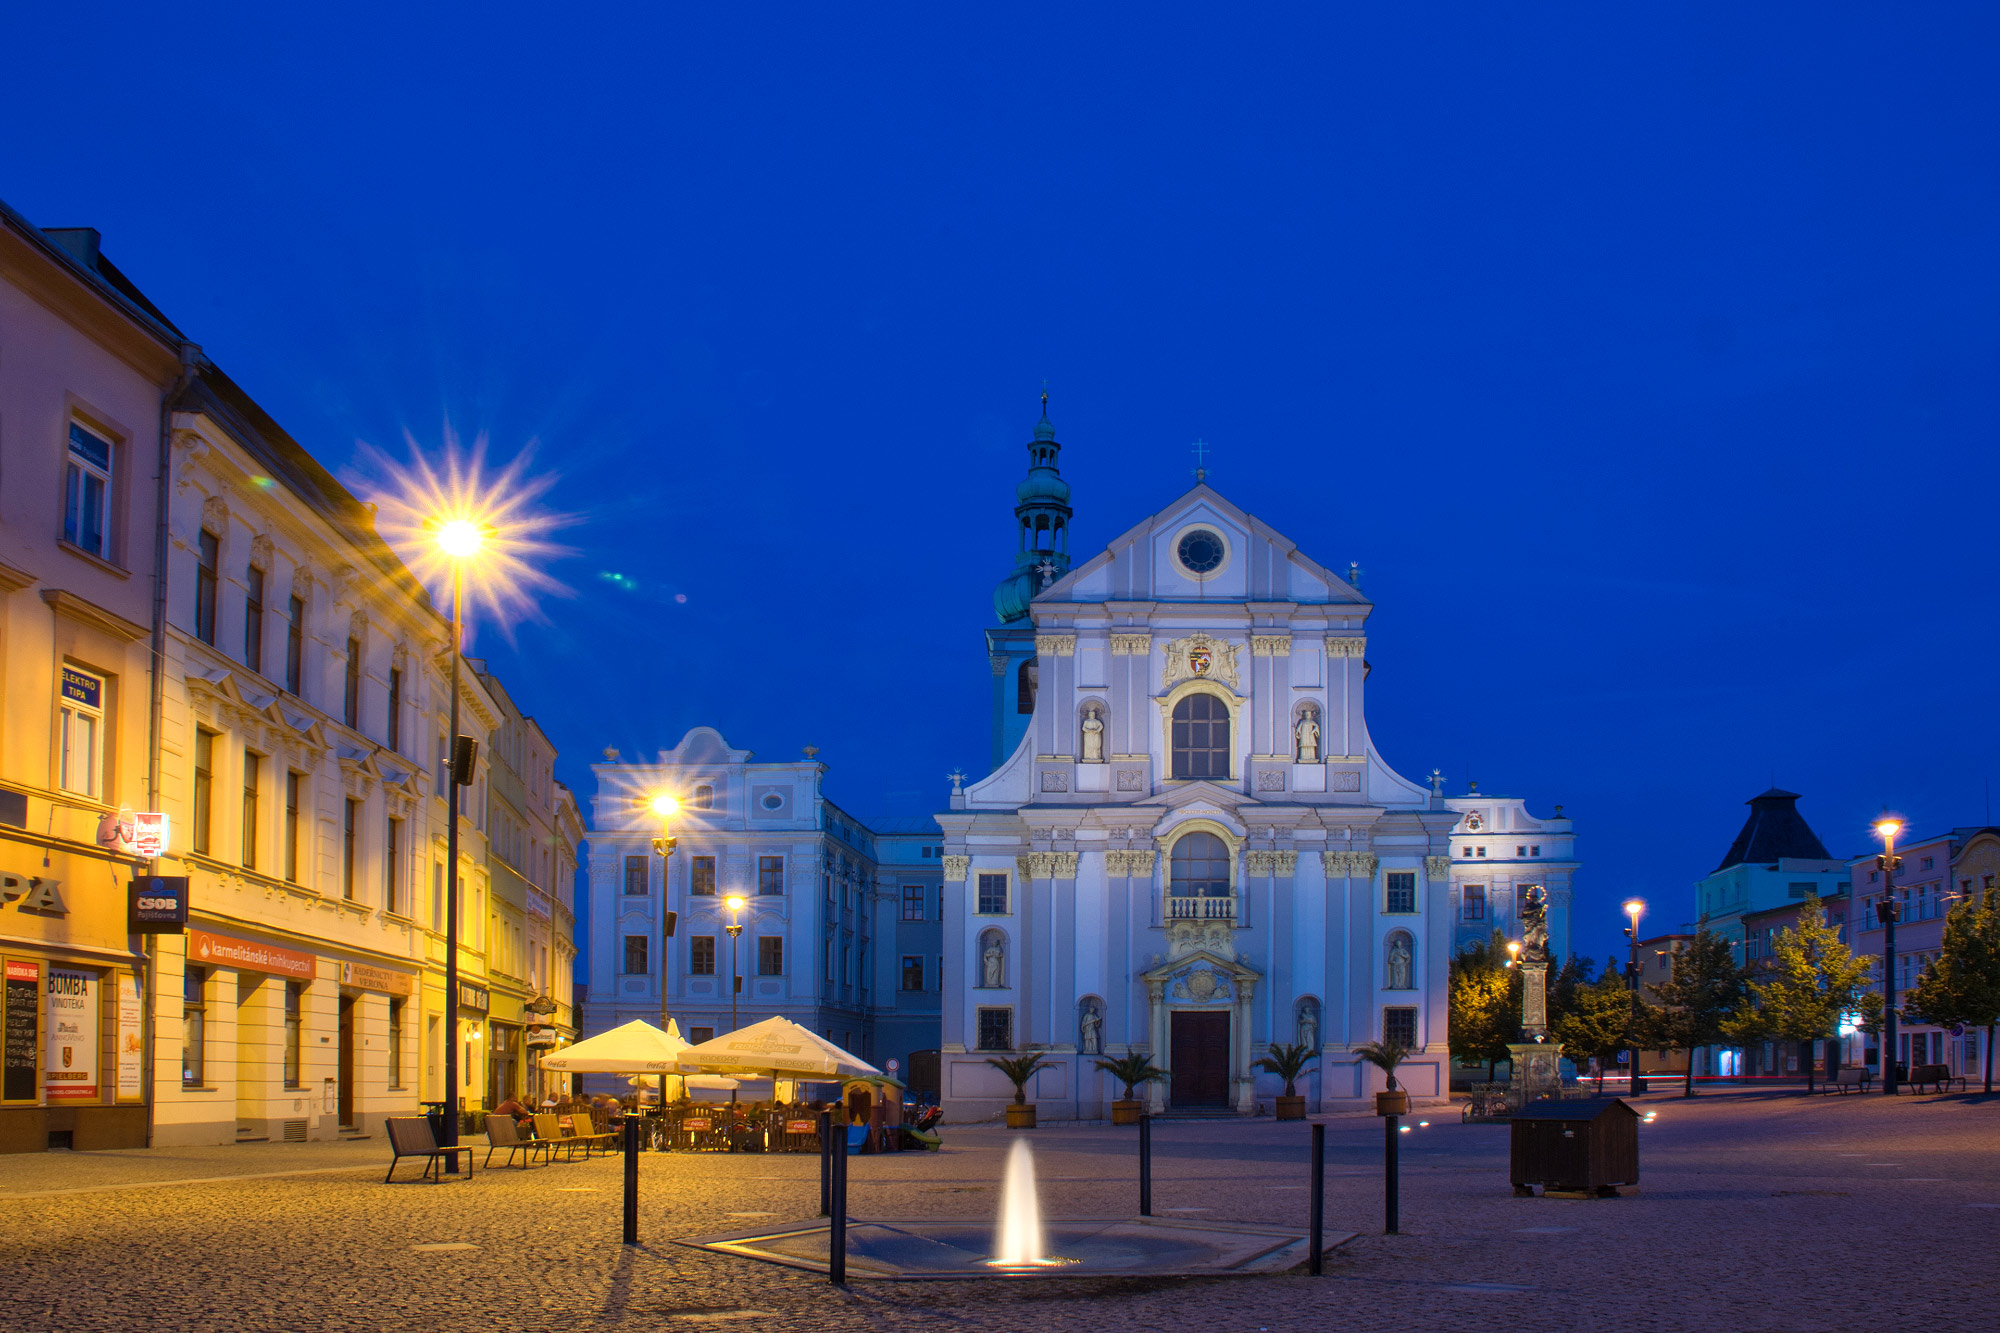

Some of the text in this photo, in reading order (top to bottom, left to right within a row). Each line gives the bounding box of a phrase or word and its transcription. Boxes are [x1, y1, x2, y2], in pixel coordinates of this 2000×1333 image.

[69, 686, 86, 700] TIPA
[137, 896, 178, 910] ČSOB
[137, 910, 177, 920] Pojišťovna
[211, 940, 311, 973] karmelitánské knihkupectví
[7, 966, 28, 977] NABÍDKA
[48, 973, 88, 996] BOMBA
[360, 978, 389, 990] VERONA
[51, 996, 85, 1009] VINOTÉKA
[700, 1055, 740, 1064] RADEGAST
[775, 1060, 816, 1070] RADEGAST
